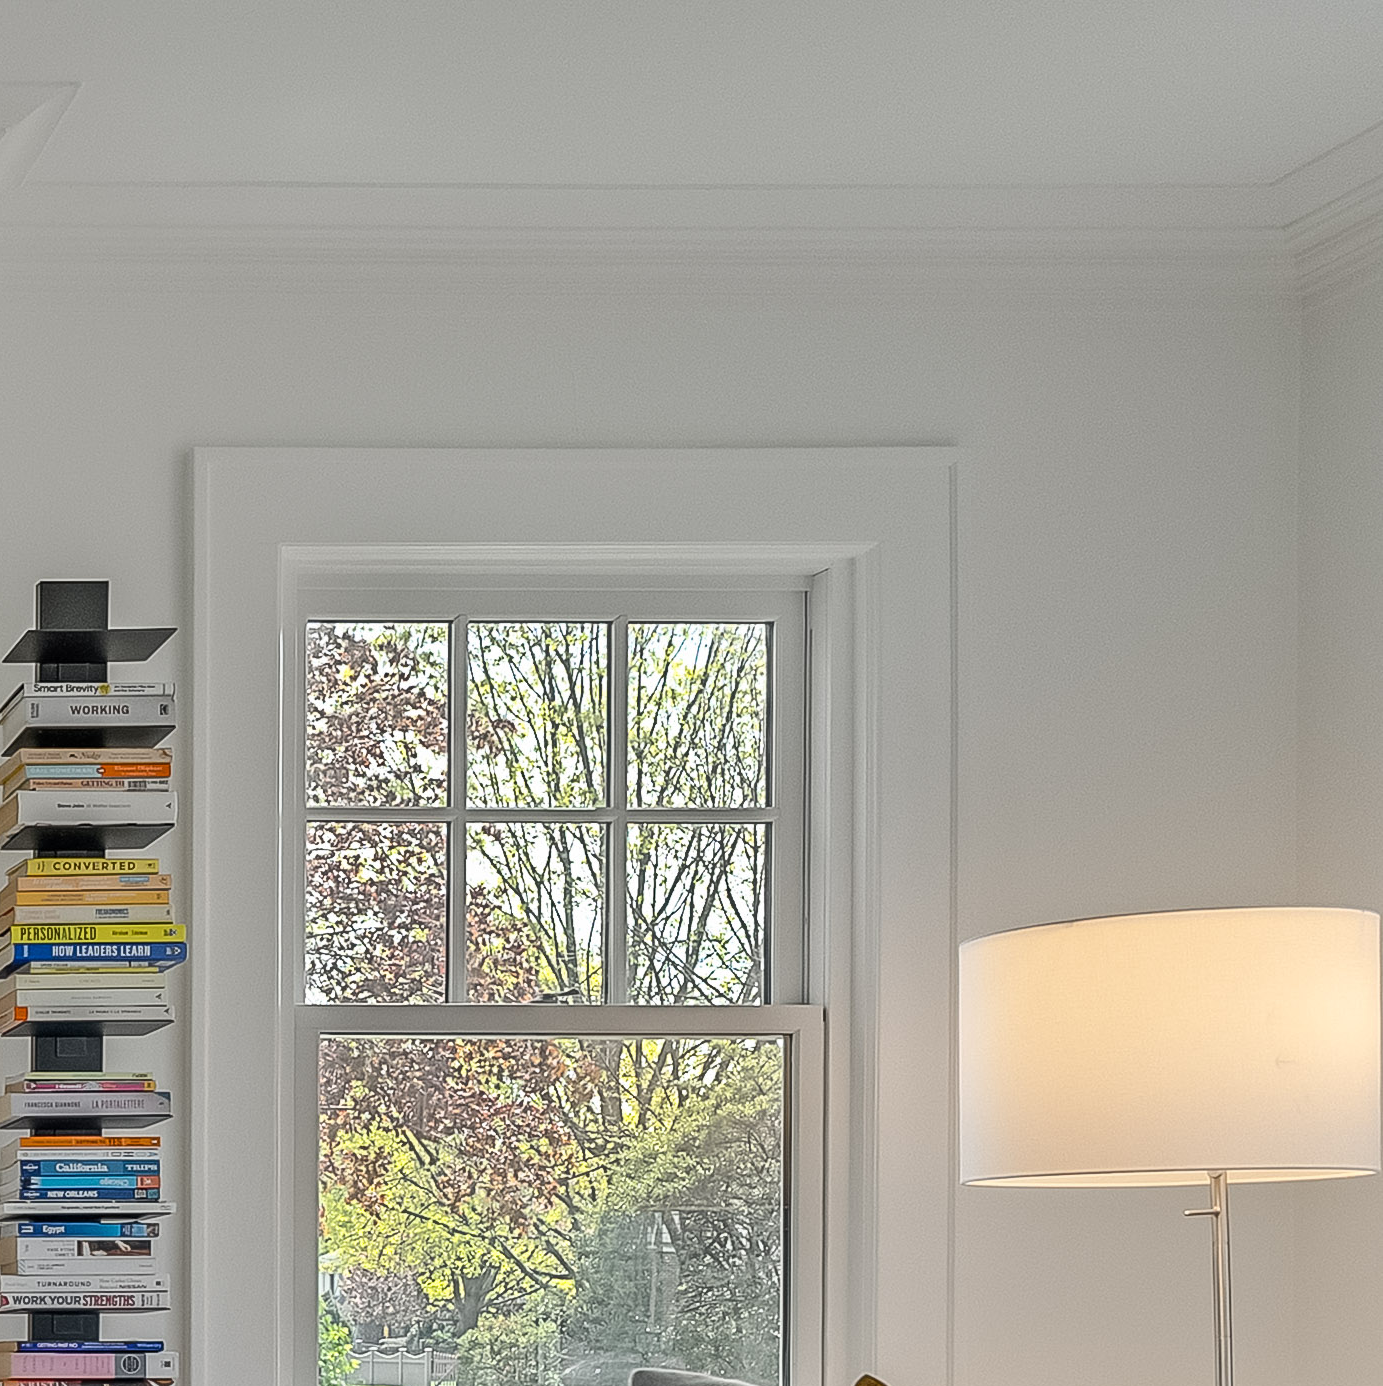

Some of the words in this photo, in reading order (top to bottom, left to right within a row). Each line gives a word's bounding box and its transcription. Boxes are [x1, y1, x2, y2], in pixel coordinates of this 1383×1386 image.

[33, 683, 64, 693] Smart
[65, 683, 99, 695] Brevity
[69, 704, 130, 716] WORKING
[80, 780, 112, 788] GETTING
[52, 861, 136, 871] CONVERTED
[19, 926, 97, 941] PERSONALIZED
[52, 945, 74, 957] HOW
[76, 945, 118, 957] LEADERS
[120, 945, 151, 957] LEARN
[24, 1101, 54, 1109] FRANCESCA
[55, 1101, 81, 1109] GIANNONE
[91, 1099, 100, 1109] LA
[100, 1099, 146, 1109] PORTALETTERE
[55, 1162, 109, 1172] California
[47, 1190, 64, 1198] NEW
[64, 1190, 98, 1198] ORLEANS
[42, 1225, 66, 1234] Egypt
[36, 1280, 92, 1288] TURNAROUND
[12, 1295, 48, 1306] WORK
[49, 1295, 81, 1306] YOUR
[82, 1295, 136, 1306] STRENGTHS
